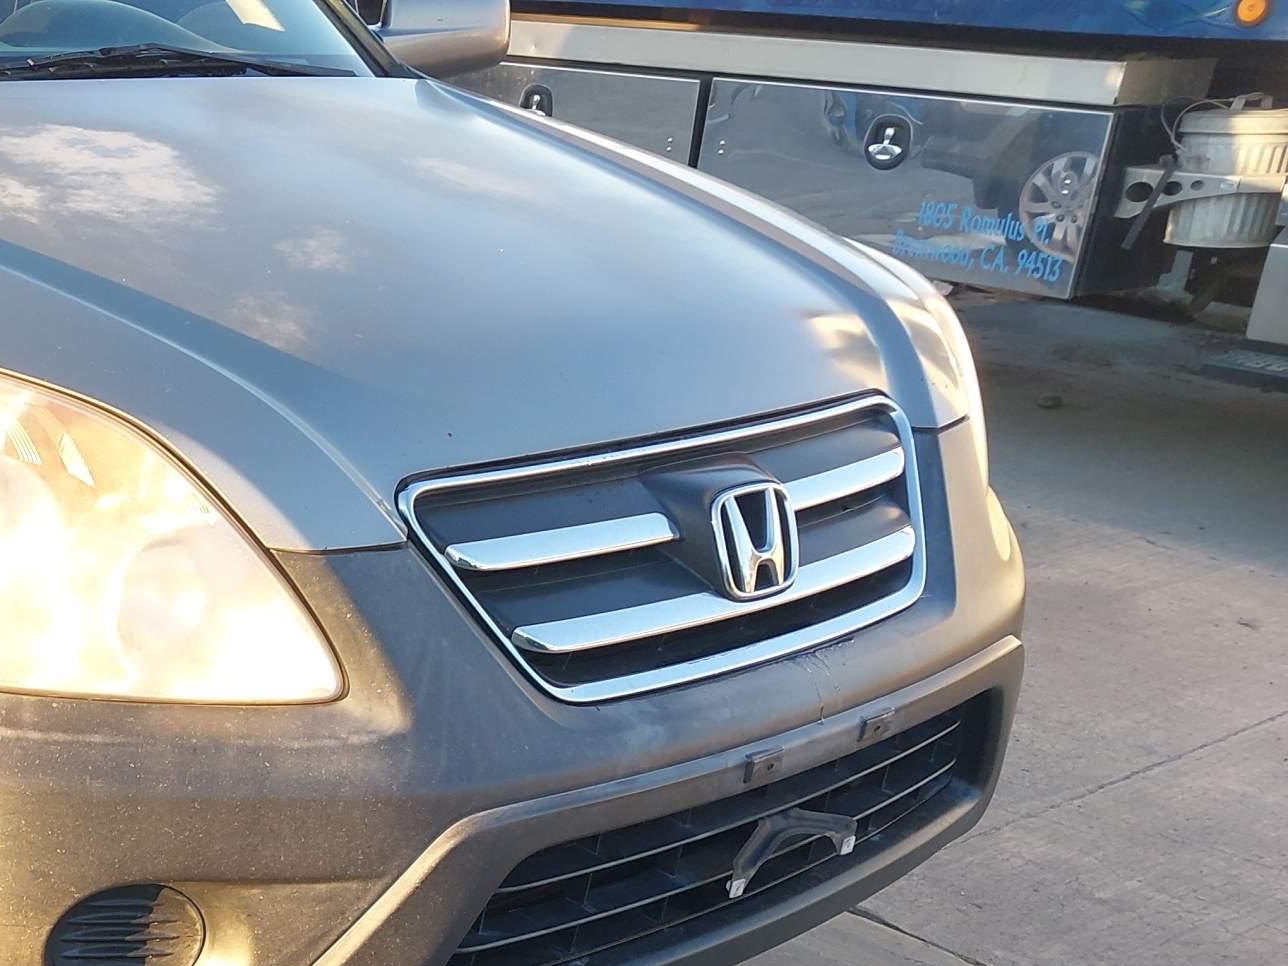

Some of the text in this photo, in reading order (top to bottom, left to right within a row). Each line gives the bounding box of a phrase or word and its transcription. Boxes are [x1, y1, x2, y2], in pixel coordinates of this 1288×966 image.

[959, 206, 1025, 242] Romulus
[979, 245, 1009, 273] CA.
[1015, 249, 1063, 283] 94513
